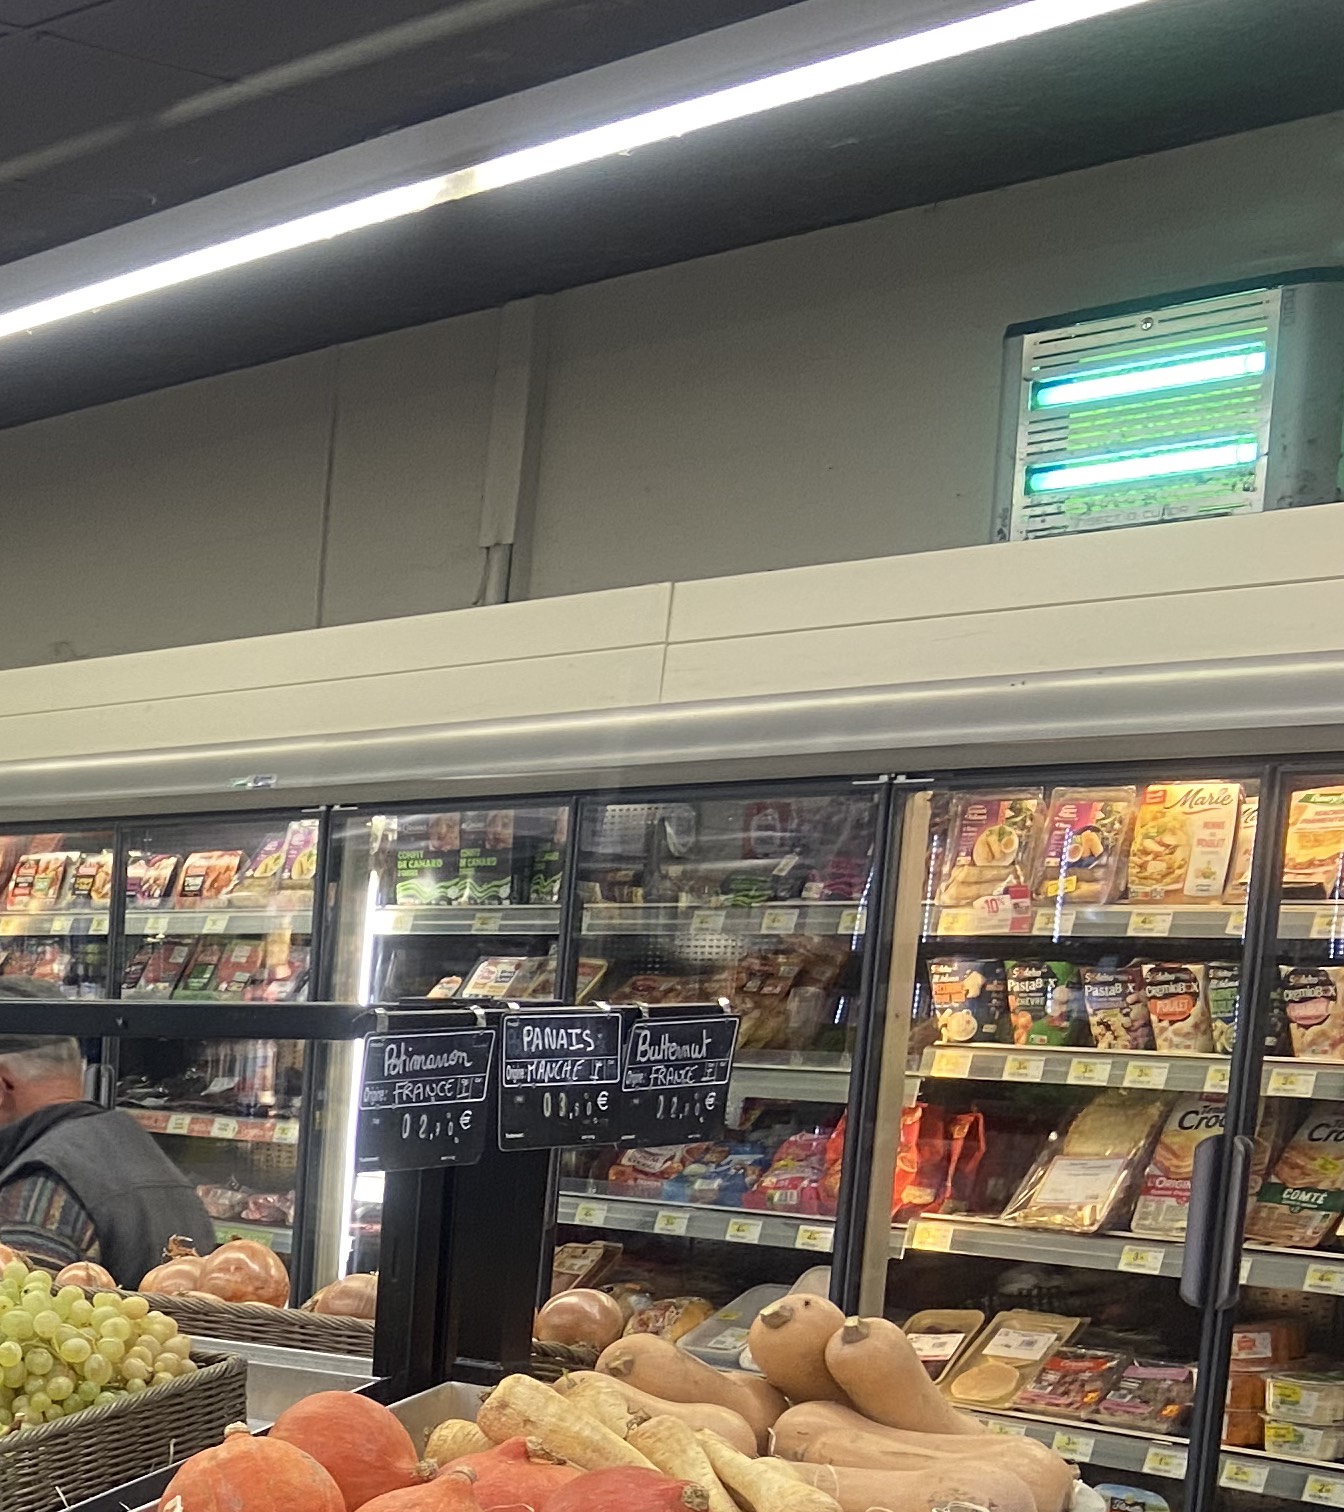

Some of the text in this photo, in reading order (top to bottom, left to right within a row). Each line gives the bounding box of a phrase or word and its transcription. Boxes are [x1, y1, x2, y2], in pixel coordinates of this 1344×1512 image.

[1163, 787, 1234, 809] Marie
[522, 1025, 596, 1052] PANAIS
[636, 1029, 712, 1062] Butternut
[527, 1060, 586, 1083] MANCHE
[649, 1064, 699, 1088] FRANCE
[392, 1079, 456, 1104] FRANCE
[1282, 1188, 1328, 1204] COMTÉ
